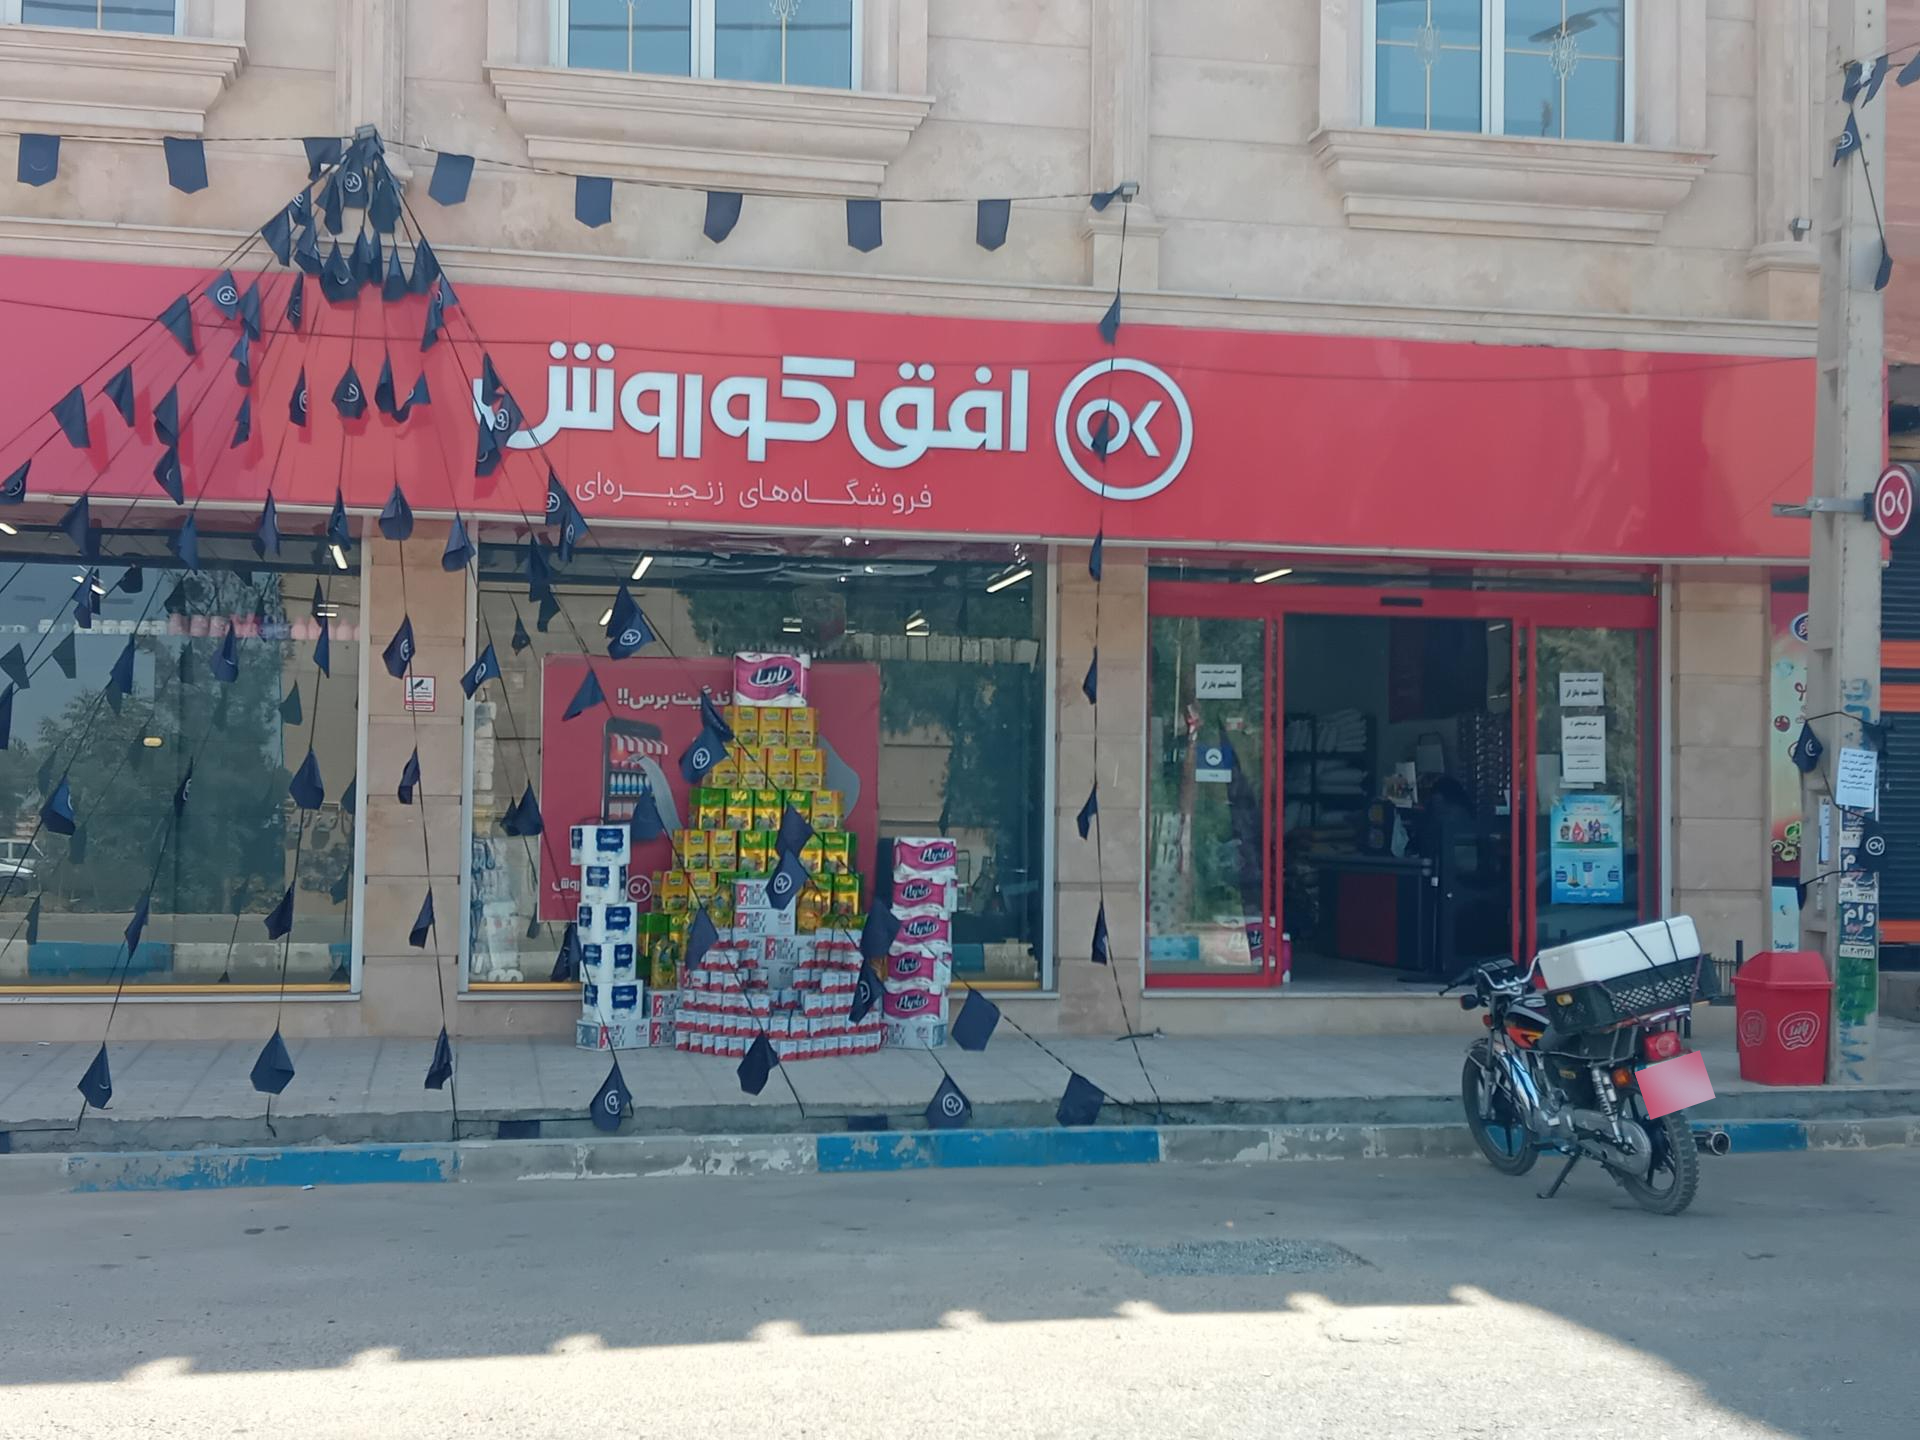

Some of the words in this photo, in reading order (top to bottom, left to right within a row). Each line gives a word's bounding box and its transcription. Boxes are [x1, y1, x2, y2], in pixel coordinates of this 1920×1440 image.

[473, 341, 855, 462] کوروش
[846, 361, 1029, 469] افق
[1076, 398, 1162, 458] OK
